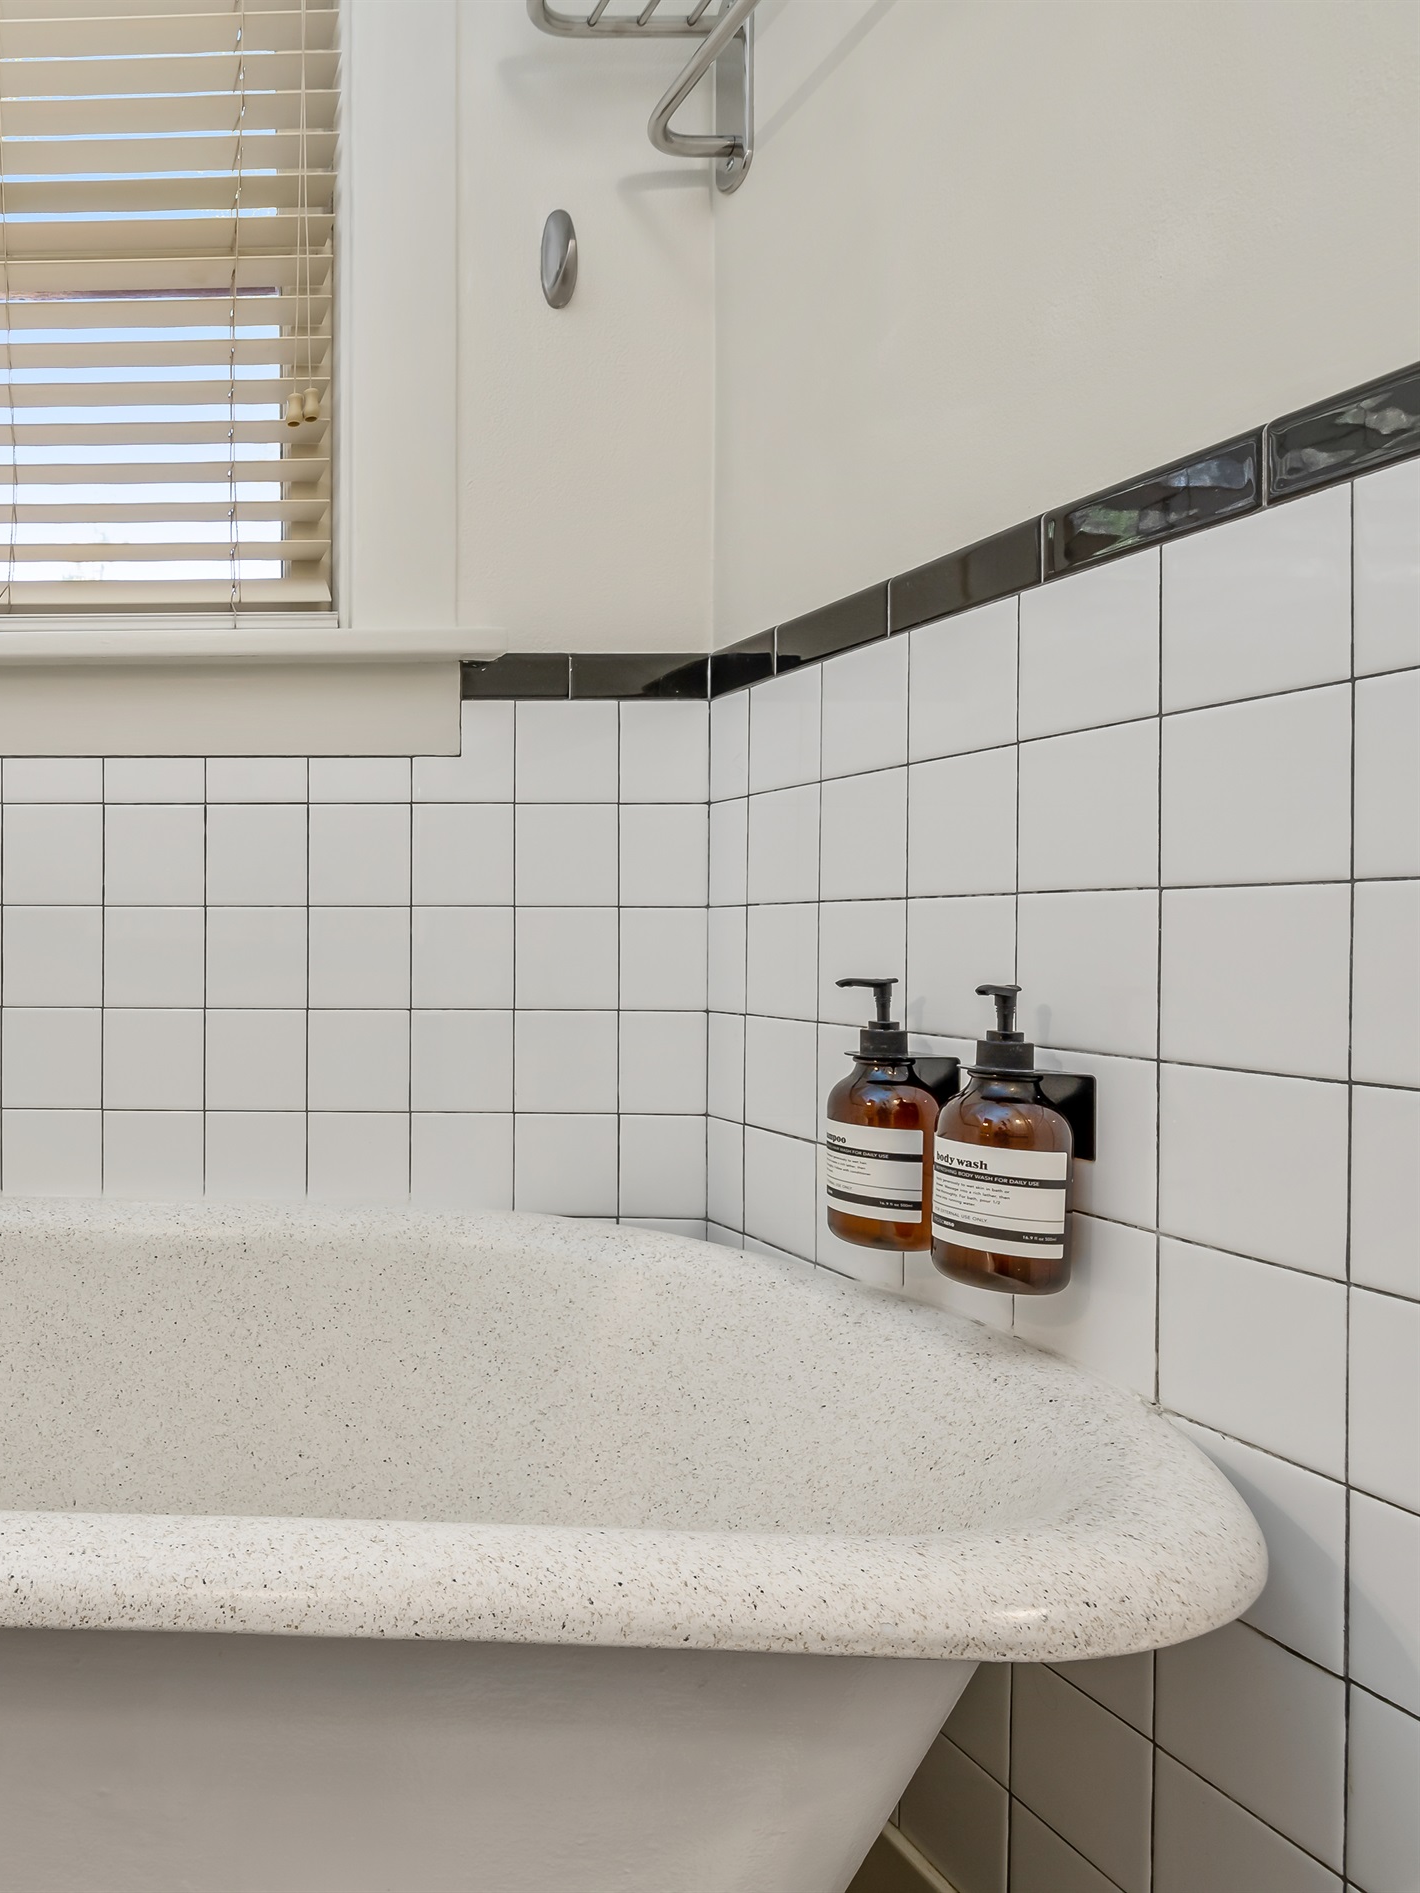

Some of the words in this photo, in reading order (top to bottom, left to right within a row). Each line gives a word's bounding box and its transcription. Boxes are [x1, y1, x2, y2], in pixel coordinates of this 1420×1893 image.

[827, 1132, 846, 1144] mpoo
[936, 1150, 955, 1165] body
[956, 1158, 988, 1170] wash
[1009, 1178, 1027, 1186] DAILY
